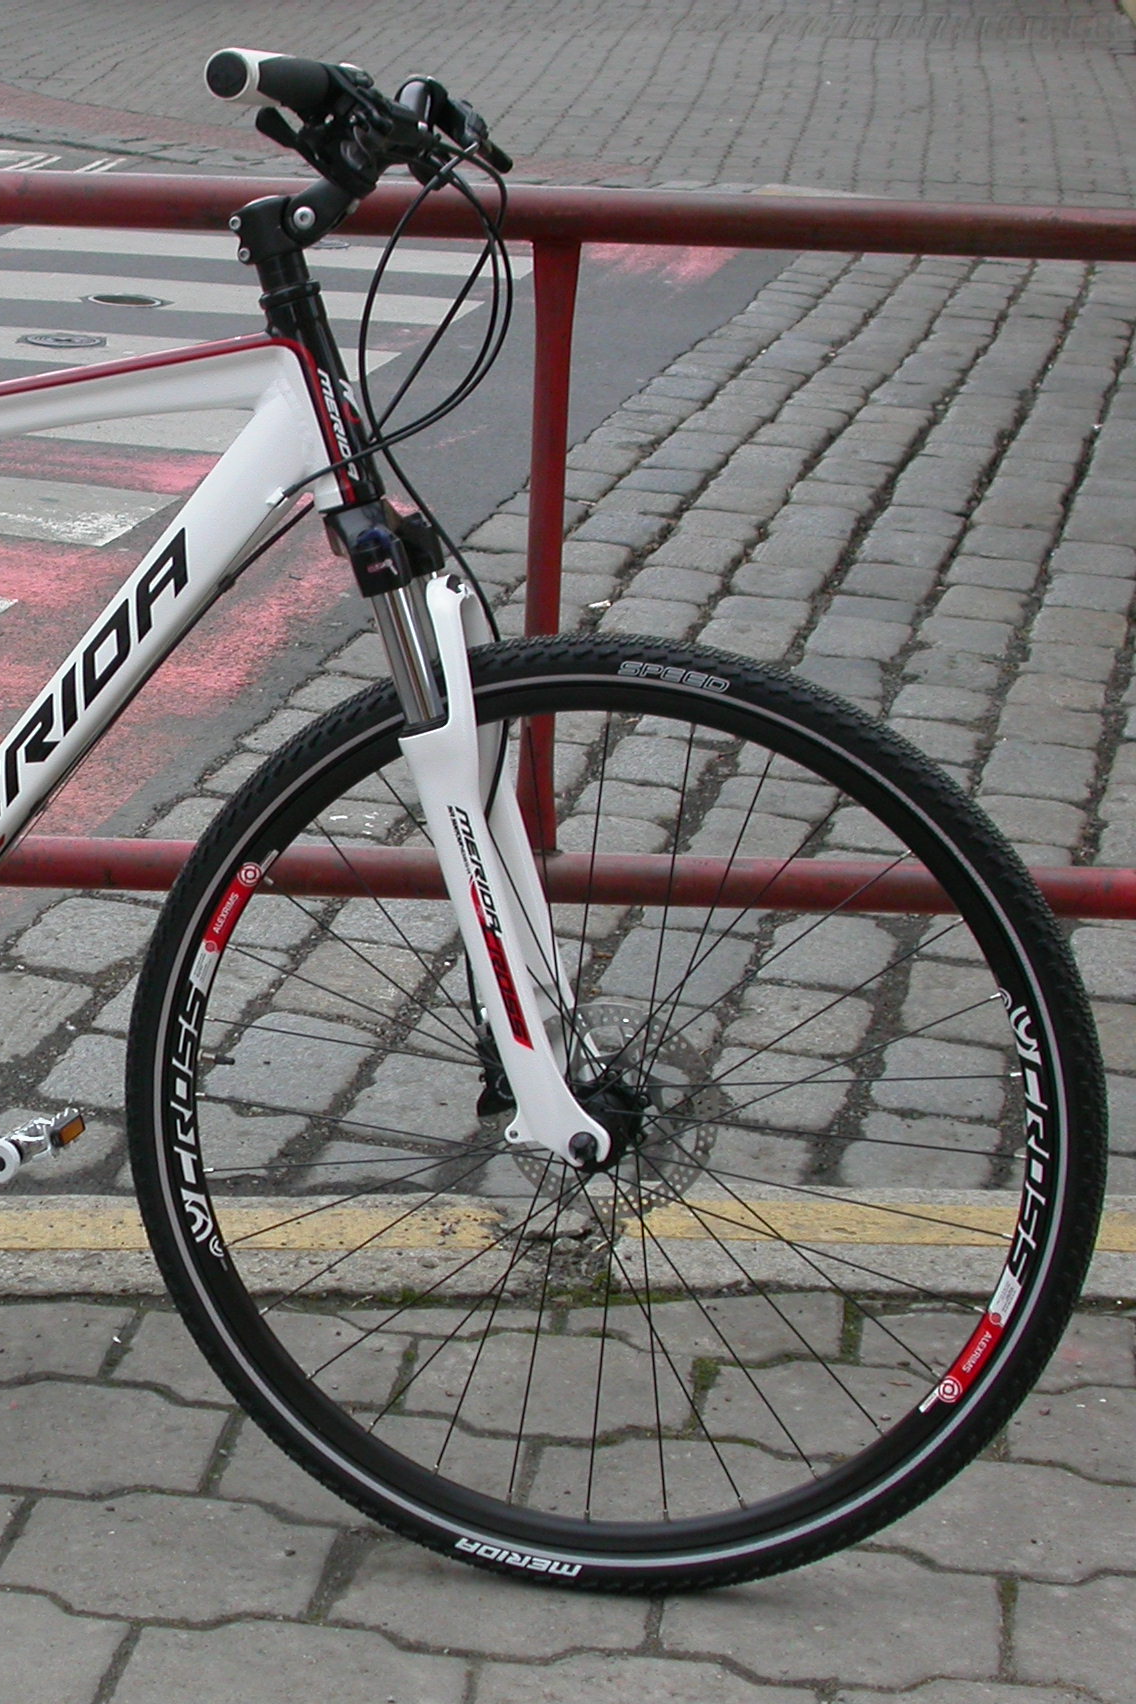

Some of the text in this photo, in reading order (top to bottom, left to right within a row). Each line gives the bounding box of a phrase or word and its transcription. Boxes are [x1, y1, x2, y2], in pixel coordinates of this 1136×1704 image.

[317, 368, 360, 481] MERIDA
[617, 660, 731, 693] SPEED
[455, 806, 503, 935] MERIDA
[212, 892, 240, 934] ALEXRIMS
[962, 1331, 993, 1374] ALEXRIMS
[455, 1537, 582, 1577] MERIDA
